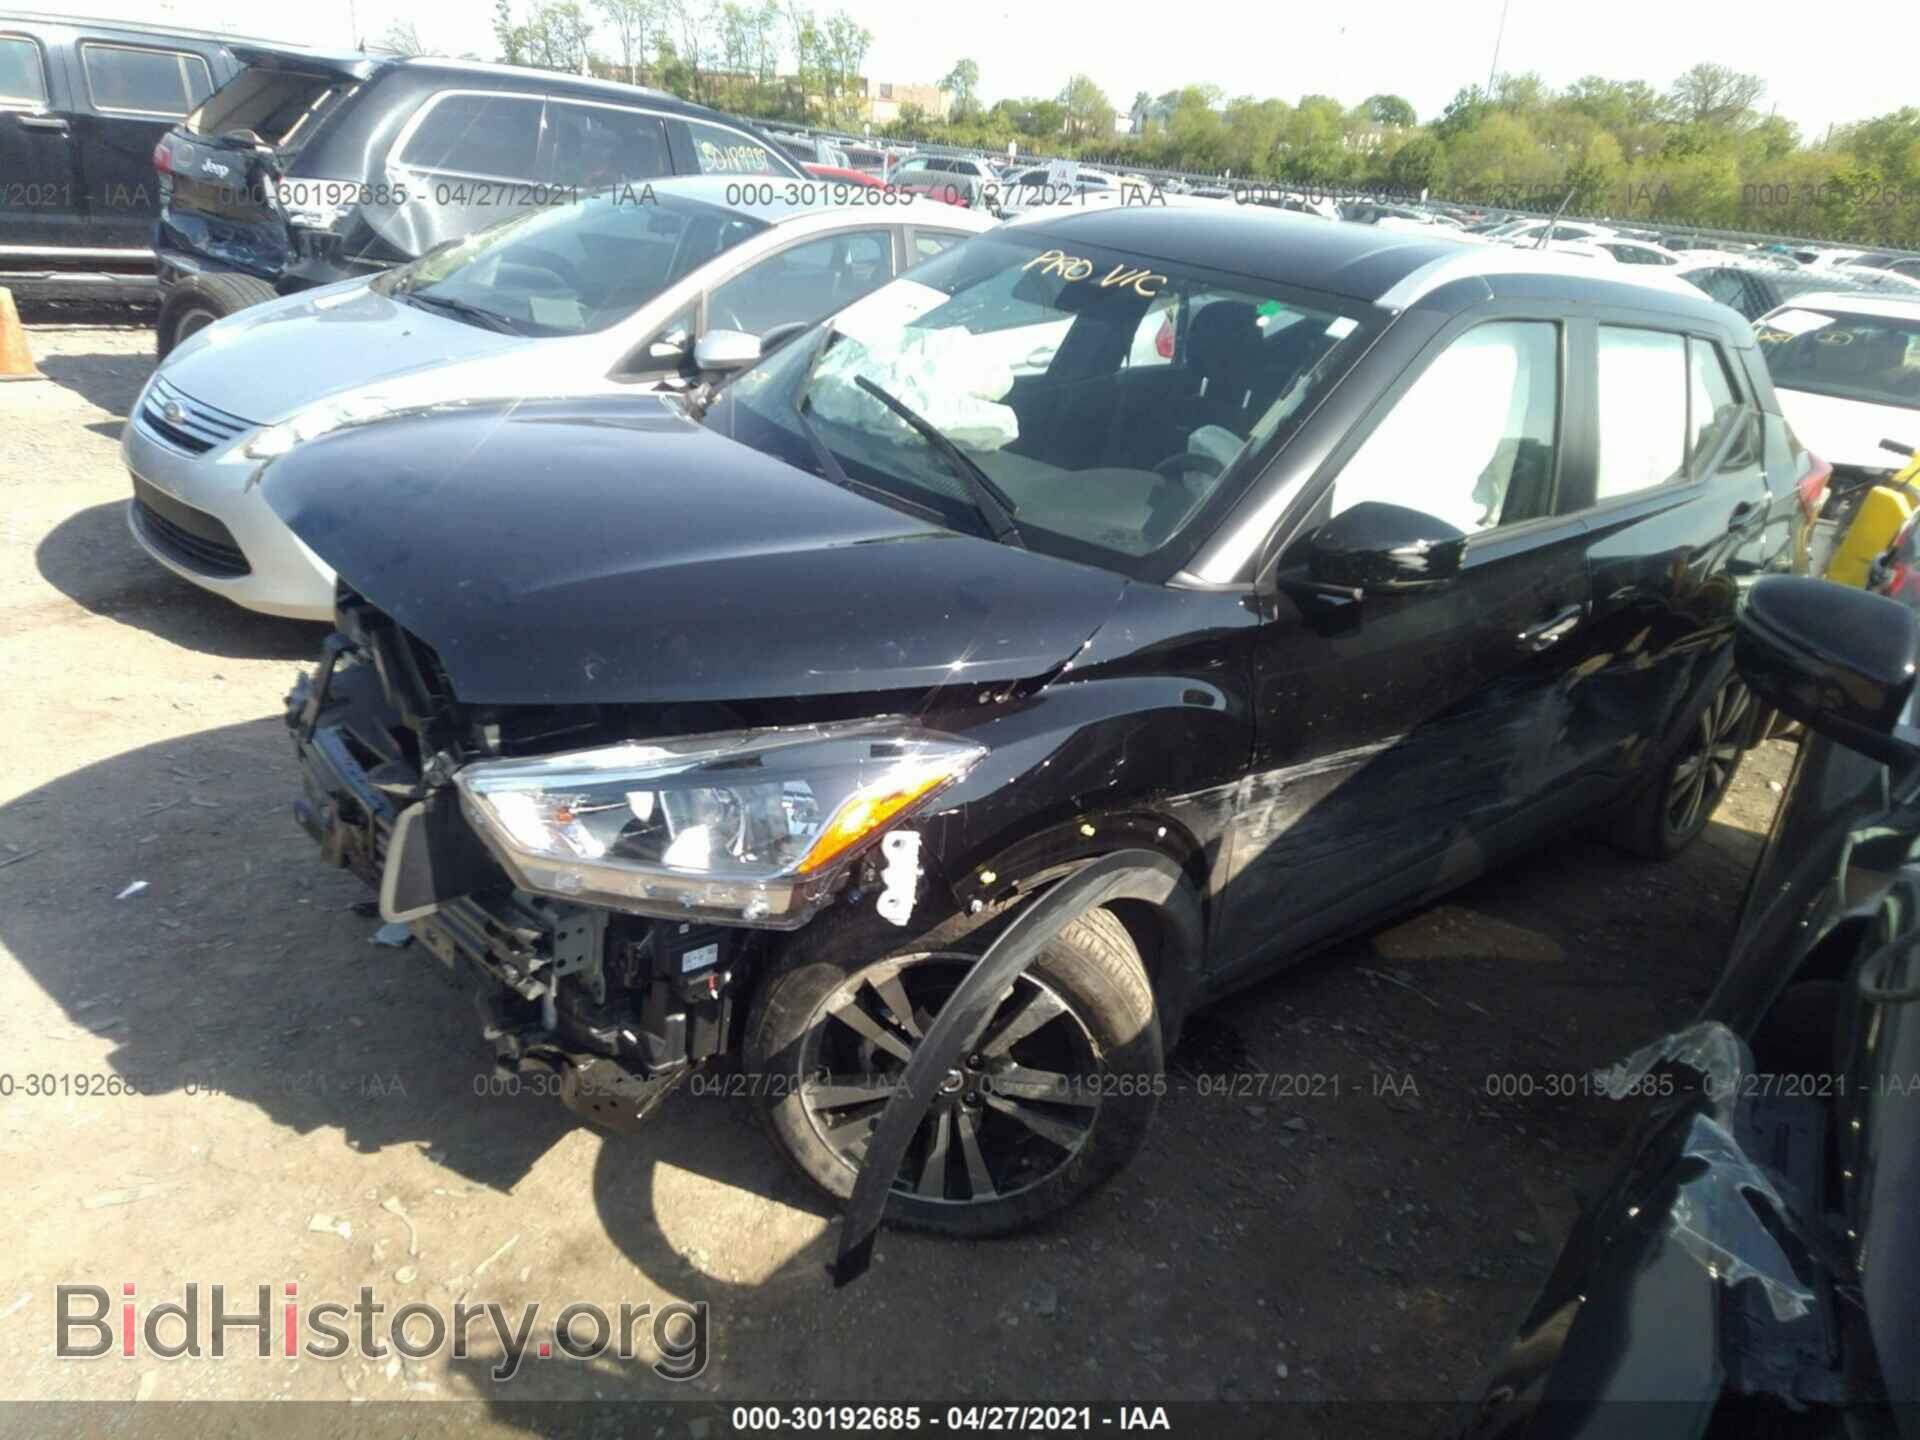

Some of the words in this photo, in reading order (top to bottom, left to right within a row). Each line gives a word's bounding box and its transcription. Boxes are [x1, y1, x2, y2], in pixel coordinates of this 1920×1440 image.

[201, 158, 230, 178] Jeep
[1022, 249, 1093, 282] PRO
[1101, 263, 1168, 297] VIC
